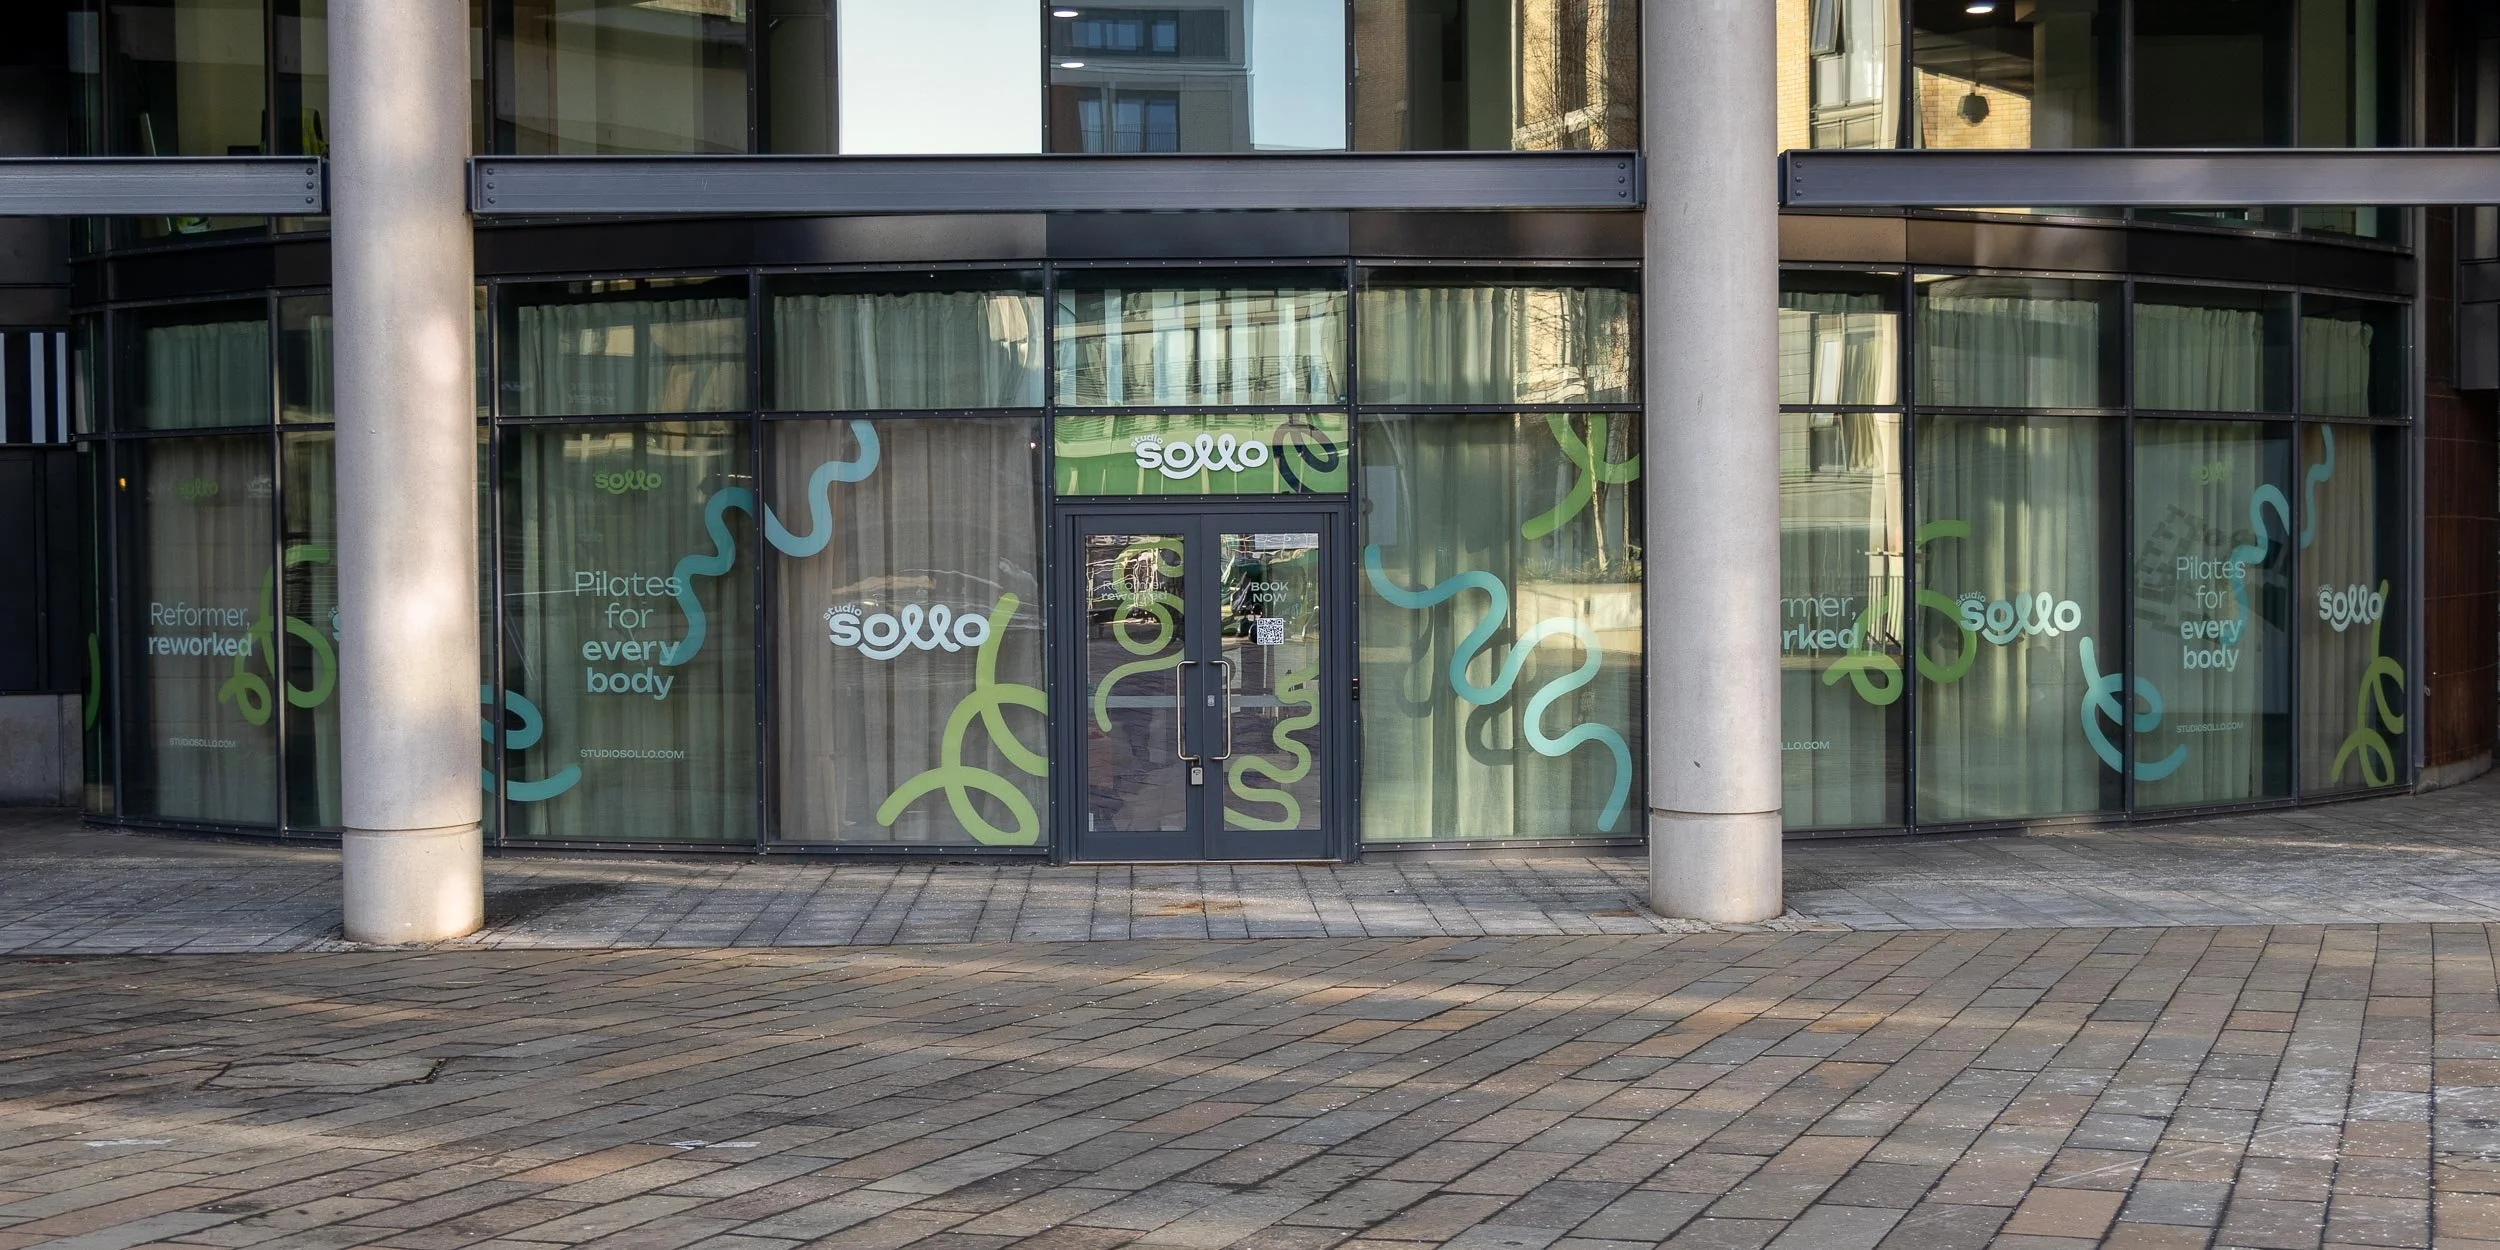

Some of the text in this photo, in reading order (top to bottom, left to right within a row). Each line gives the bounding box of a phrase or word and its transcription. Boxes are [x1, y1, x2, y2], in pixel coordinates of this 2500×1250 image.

[1131, 434, 1163, 448] studio
[1135, 433, 1269, 480] sollo
[594, 468, 662, 495] sollo
[2177, 556, 2246, 580] Pilates
[575, 570, 682, 597] Pilates
[1251, 582, 1289, 591] BOOK
[1252, 593, 1287, 602] NOW
[1780, 597, 1857, 620] rmer,
[1955, 591, 1987, 607] studio
[2196, 585, 2227, 609] for
[2319, 584, 2382, 632] sollo
[151, 602, 250, 631] Reformer,
[605, 602, 654, 629] for
[823, 604, 863, 621] studio
[1960, 591, 2082, 645] sollo
[149, 632, 253, 657] reworked
[829, 603, 991, 661] sollo
[1781, 623, 1860, 650] rked
[2180, 620, 2242, 643] every
[582, 640, 680, 666] every
[2183, 644, 2240, 672] body
[587, 666, 675, 700] body
[580, 749, 684, 759] STUDIOSOLLO.COM
